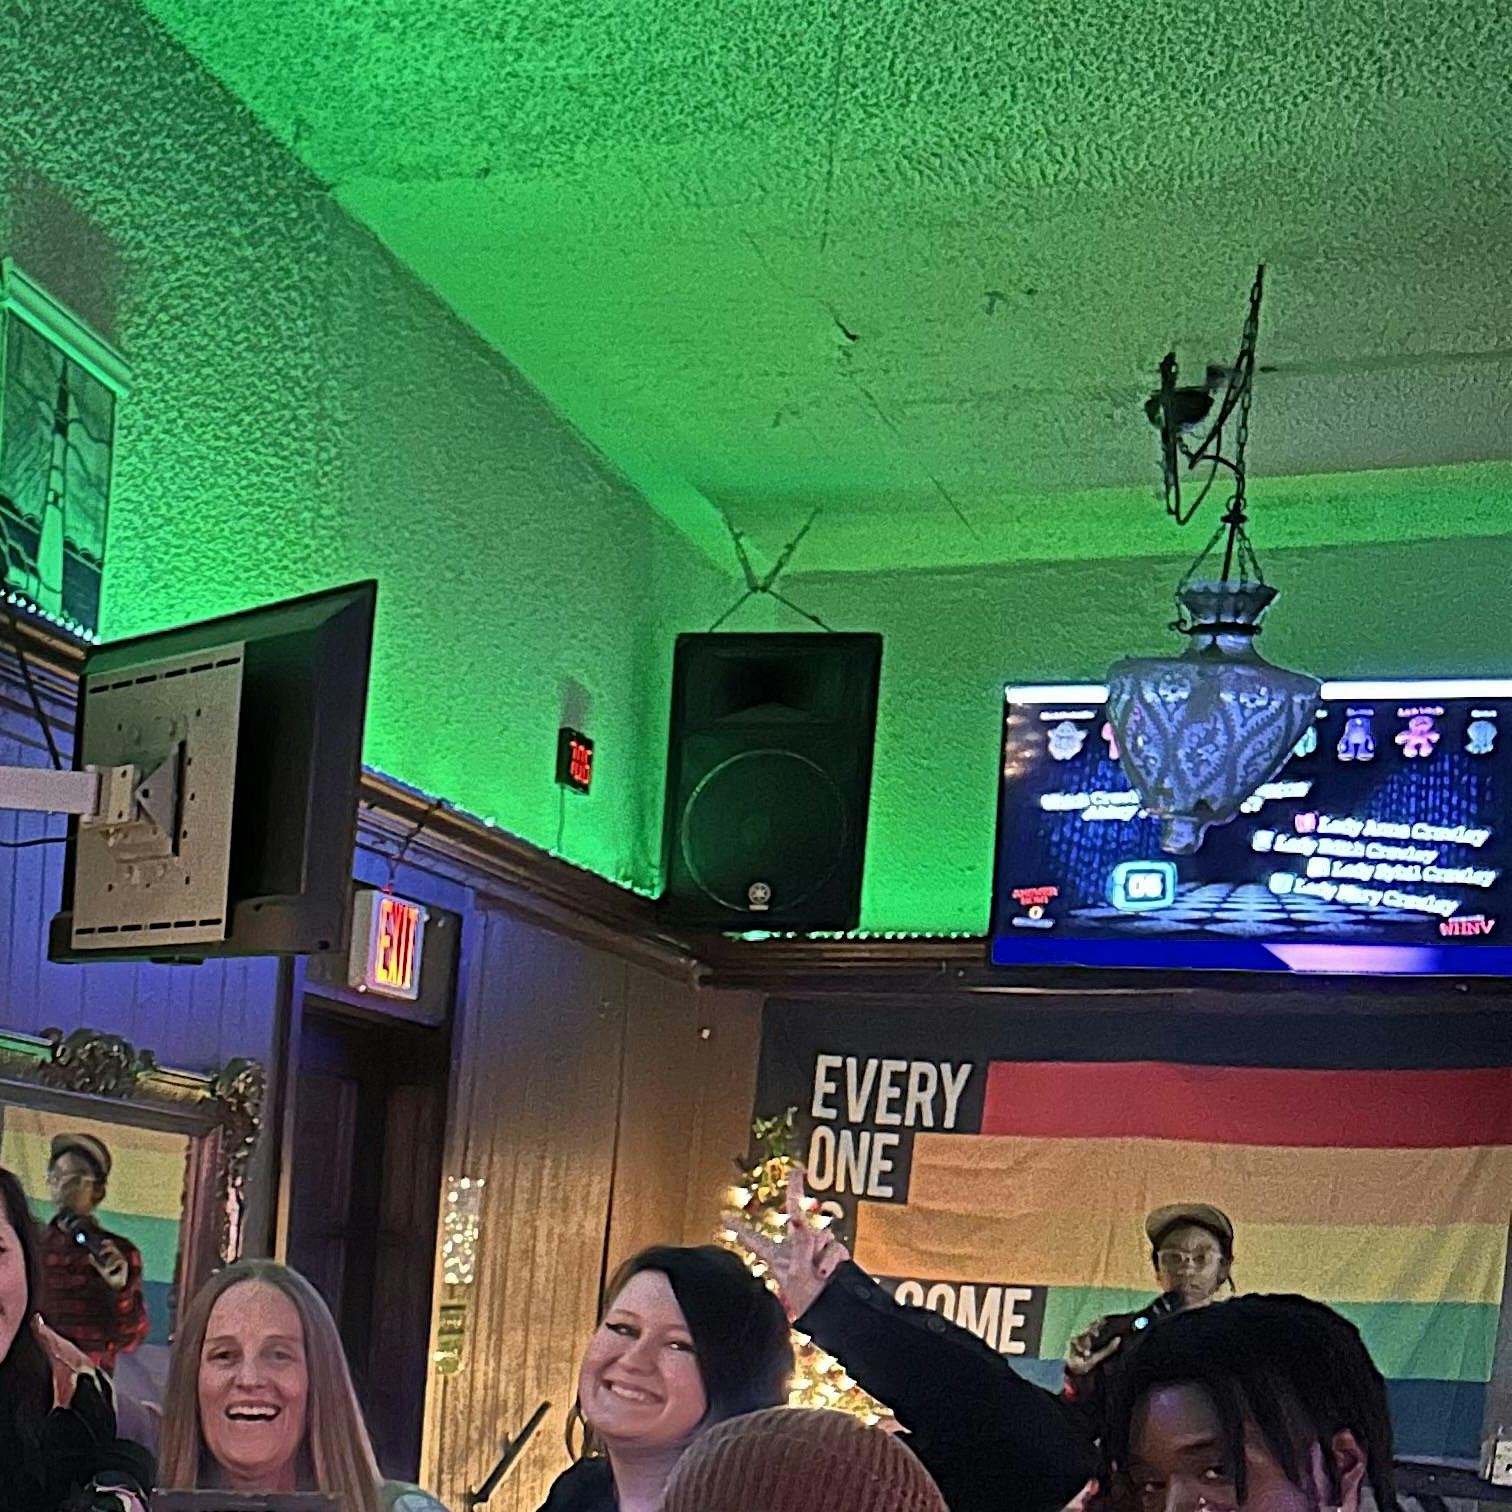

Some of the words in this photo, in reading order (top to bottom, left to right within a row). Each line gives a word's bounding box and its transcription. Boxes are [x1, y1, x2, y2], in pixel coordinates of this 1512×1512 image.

[375, 898, 420, 990] EXIT
[812, 1054, 973, 1129] EVERY
[808, 1126, 900, 1199] ONE
